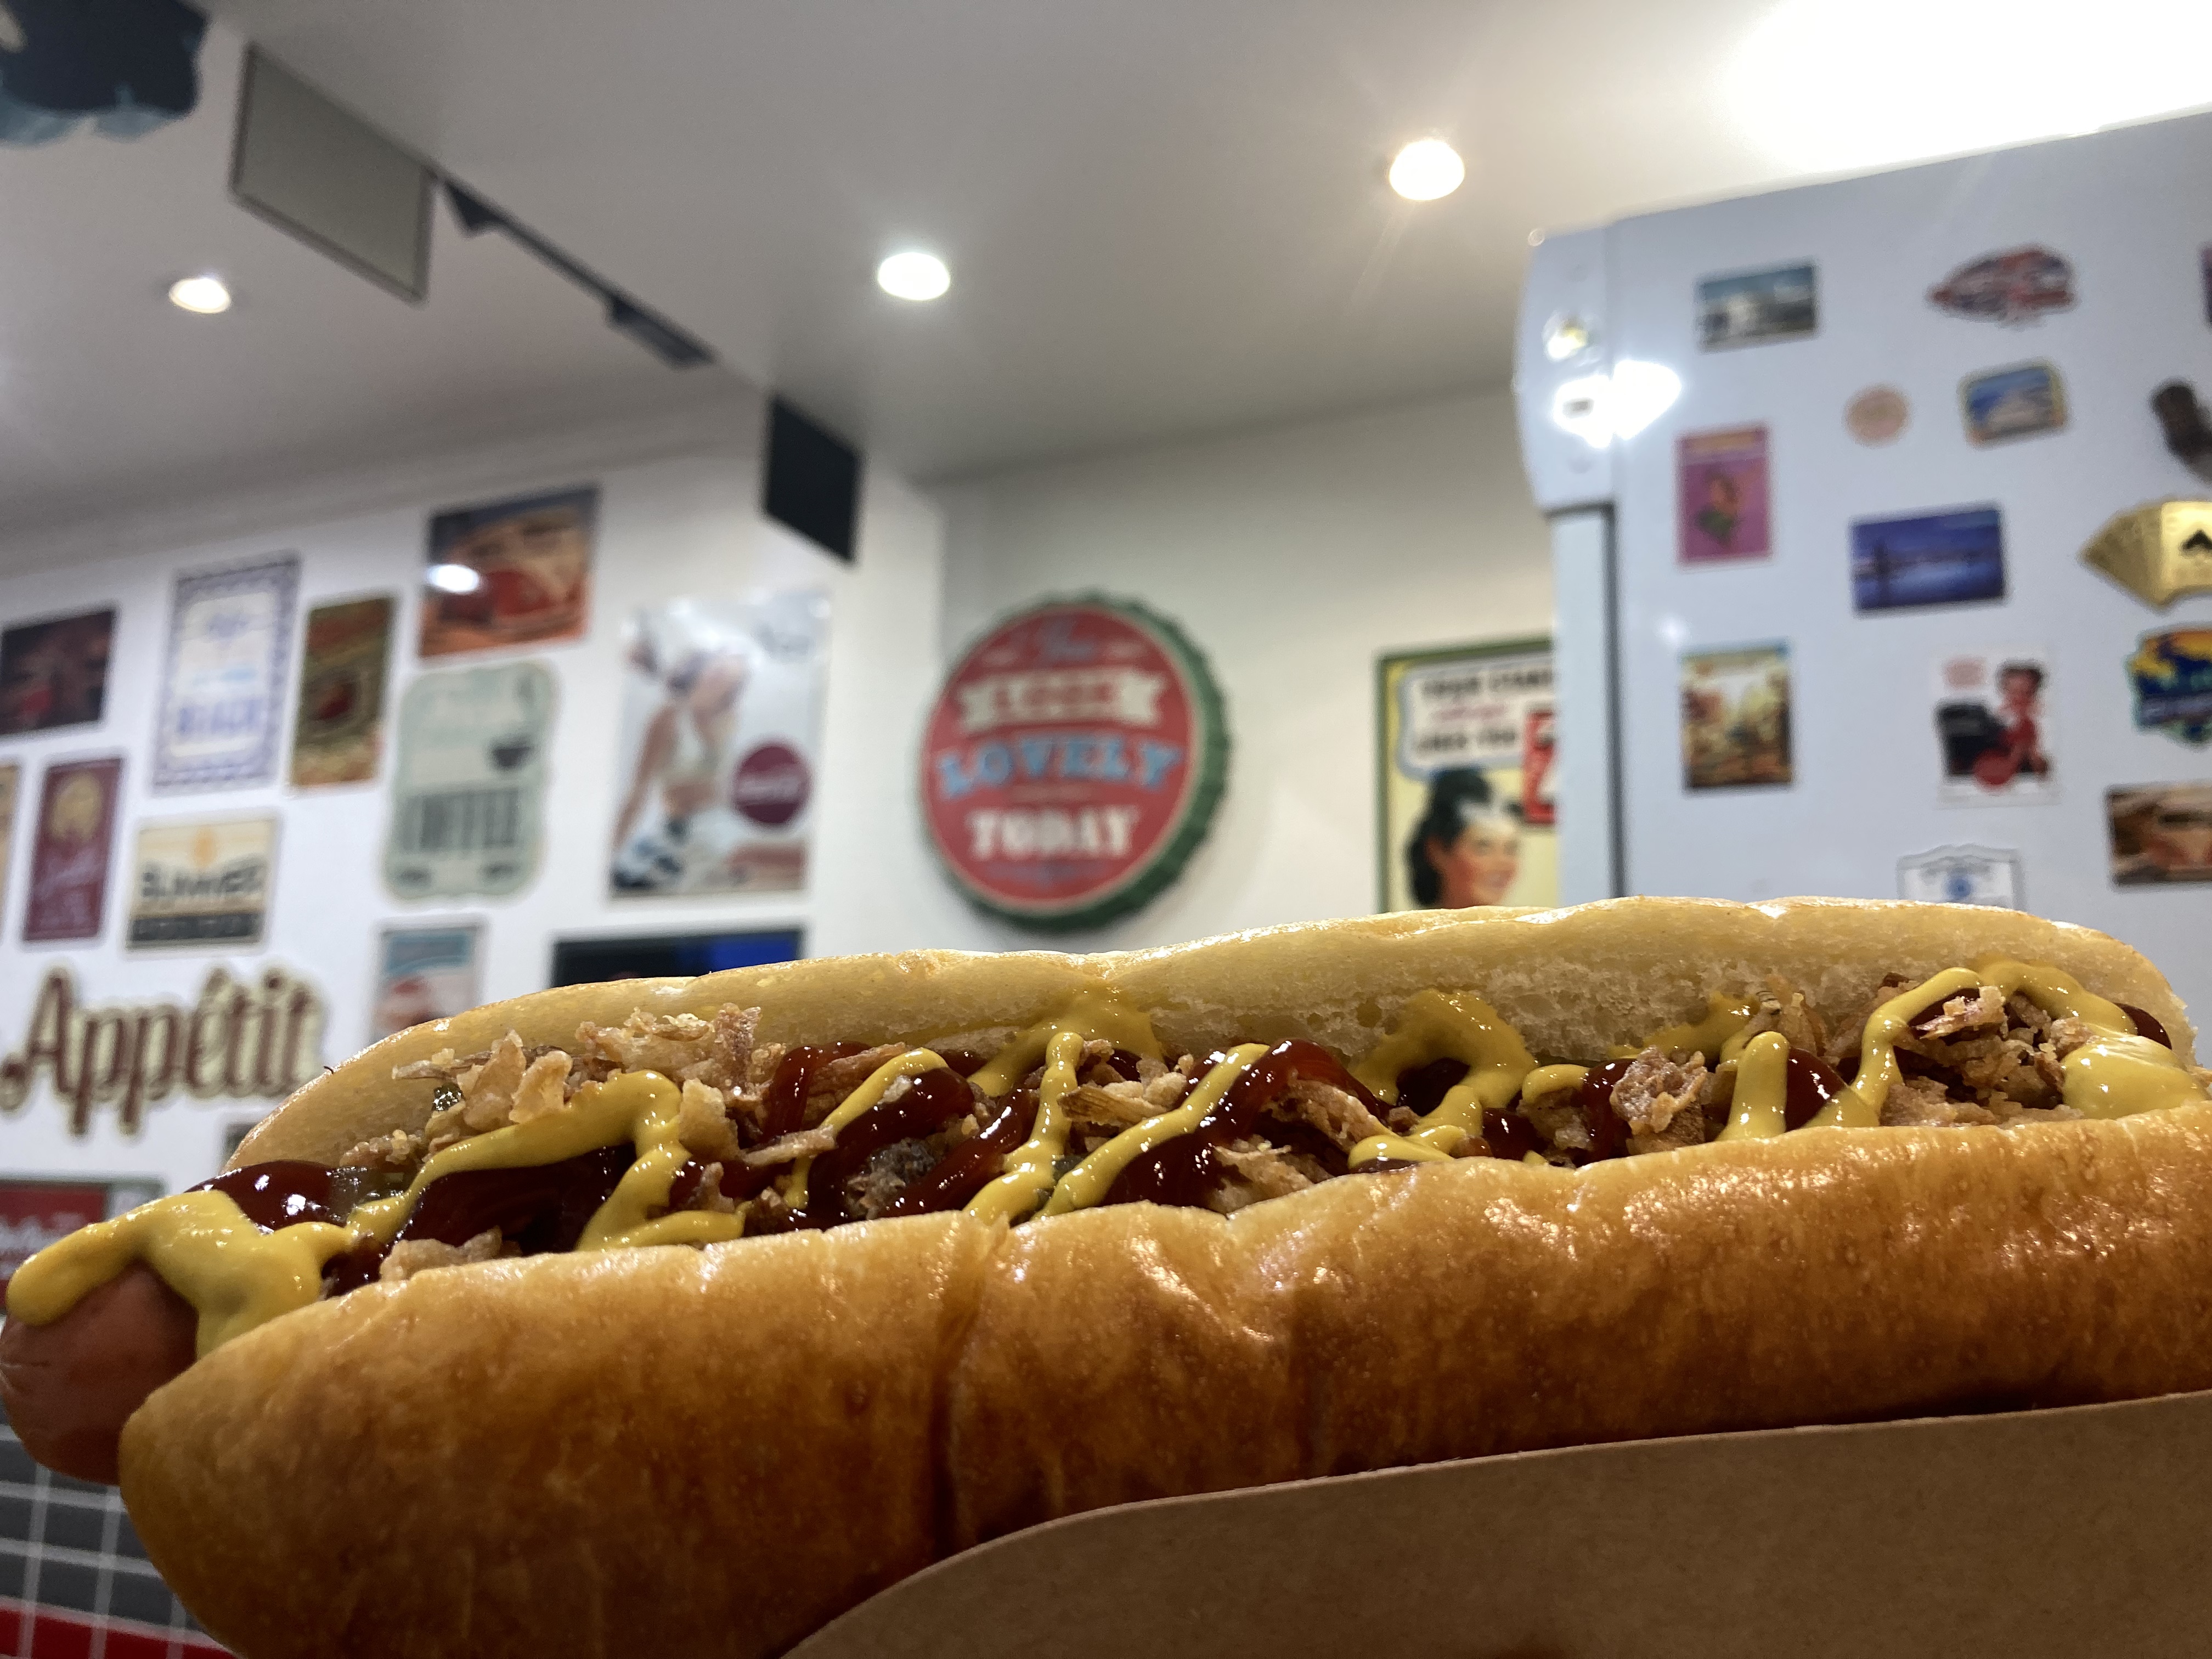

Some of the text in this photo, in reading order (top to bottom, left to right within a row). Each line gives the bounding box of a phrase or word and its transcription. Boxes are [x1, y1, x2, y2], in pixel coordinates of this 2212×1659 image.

[937, 733, 1183, 800] LOVELY
[966, 806, 1140, 860] TODAY
[0, 966, 318, 1136] Appétit
